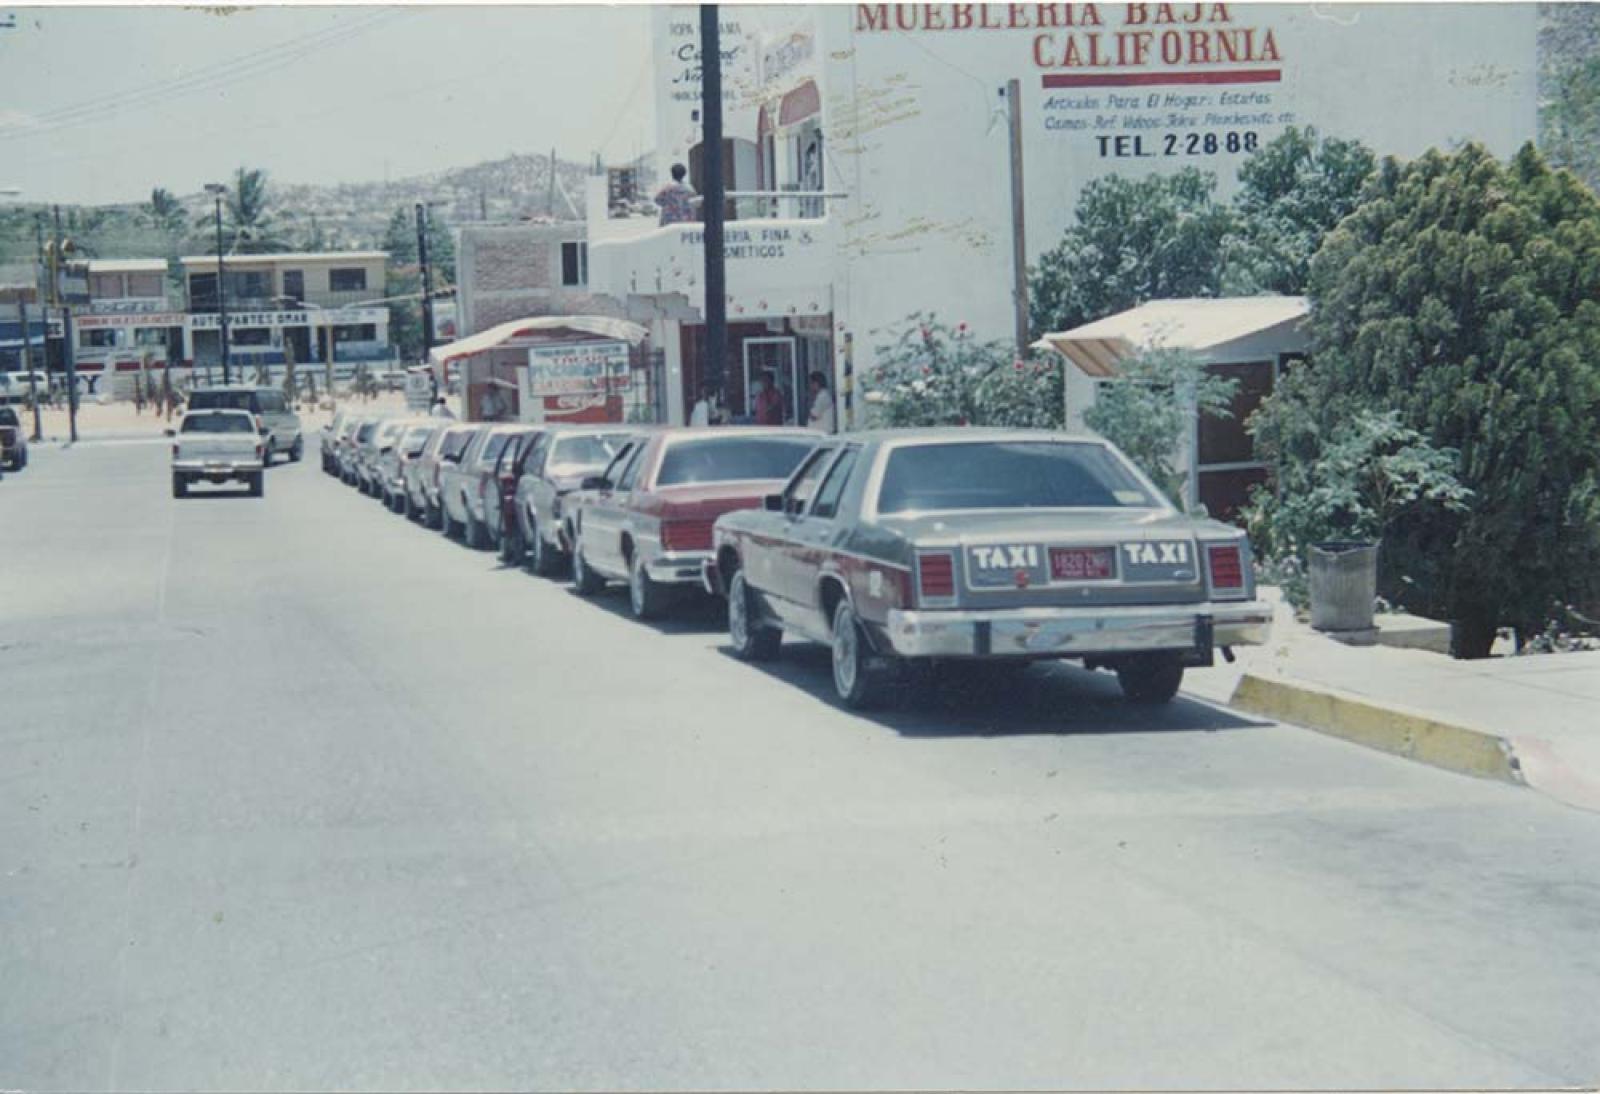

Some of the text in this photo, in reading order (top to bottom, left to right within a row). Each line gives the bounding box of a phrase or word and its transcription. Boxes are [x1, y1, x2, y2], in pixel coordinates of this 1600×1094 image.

[855, 3, 1231, 32] MUEBLERIA BAJA
[1033, 29, 1282, 67] CALIFORNIA
[1095, 134, 1157, 158] TEL.
[761, 229, 791, 241] FINA
[972, 545, 1038, 569] TAXI
[1123, 543, 1188, 564] TAXI
